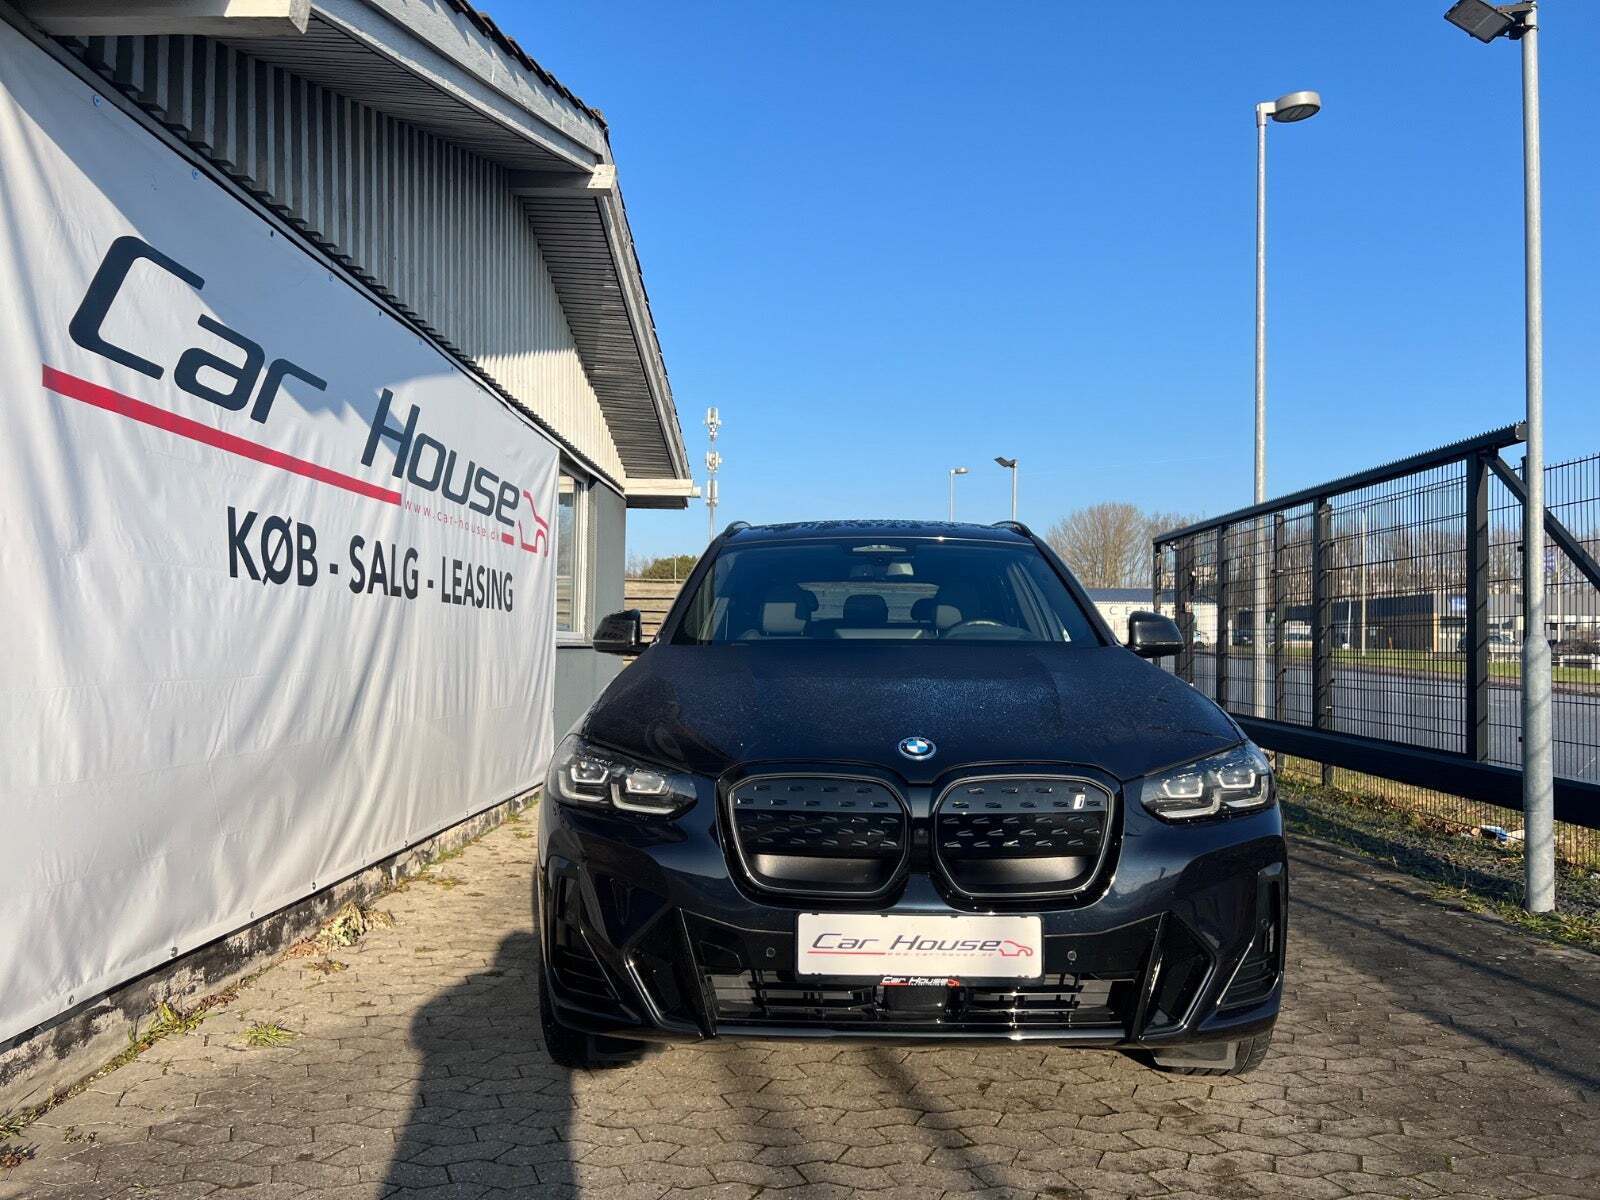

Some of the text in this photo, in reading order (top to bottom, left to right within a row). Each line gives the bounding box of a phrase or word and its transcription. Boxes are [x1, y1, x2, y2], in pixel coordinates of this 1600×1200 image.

[69, 235, 520, 527] Car House
[227, 506, 318, 587] KØB
[349, 534, 418, 600] SALG
[441, 556, 513, 612] LEASING
[812, 933, 1002, 952] Car House
